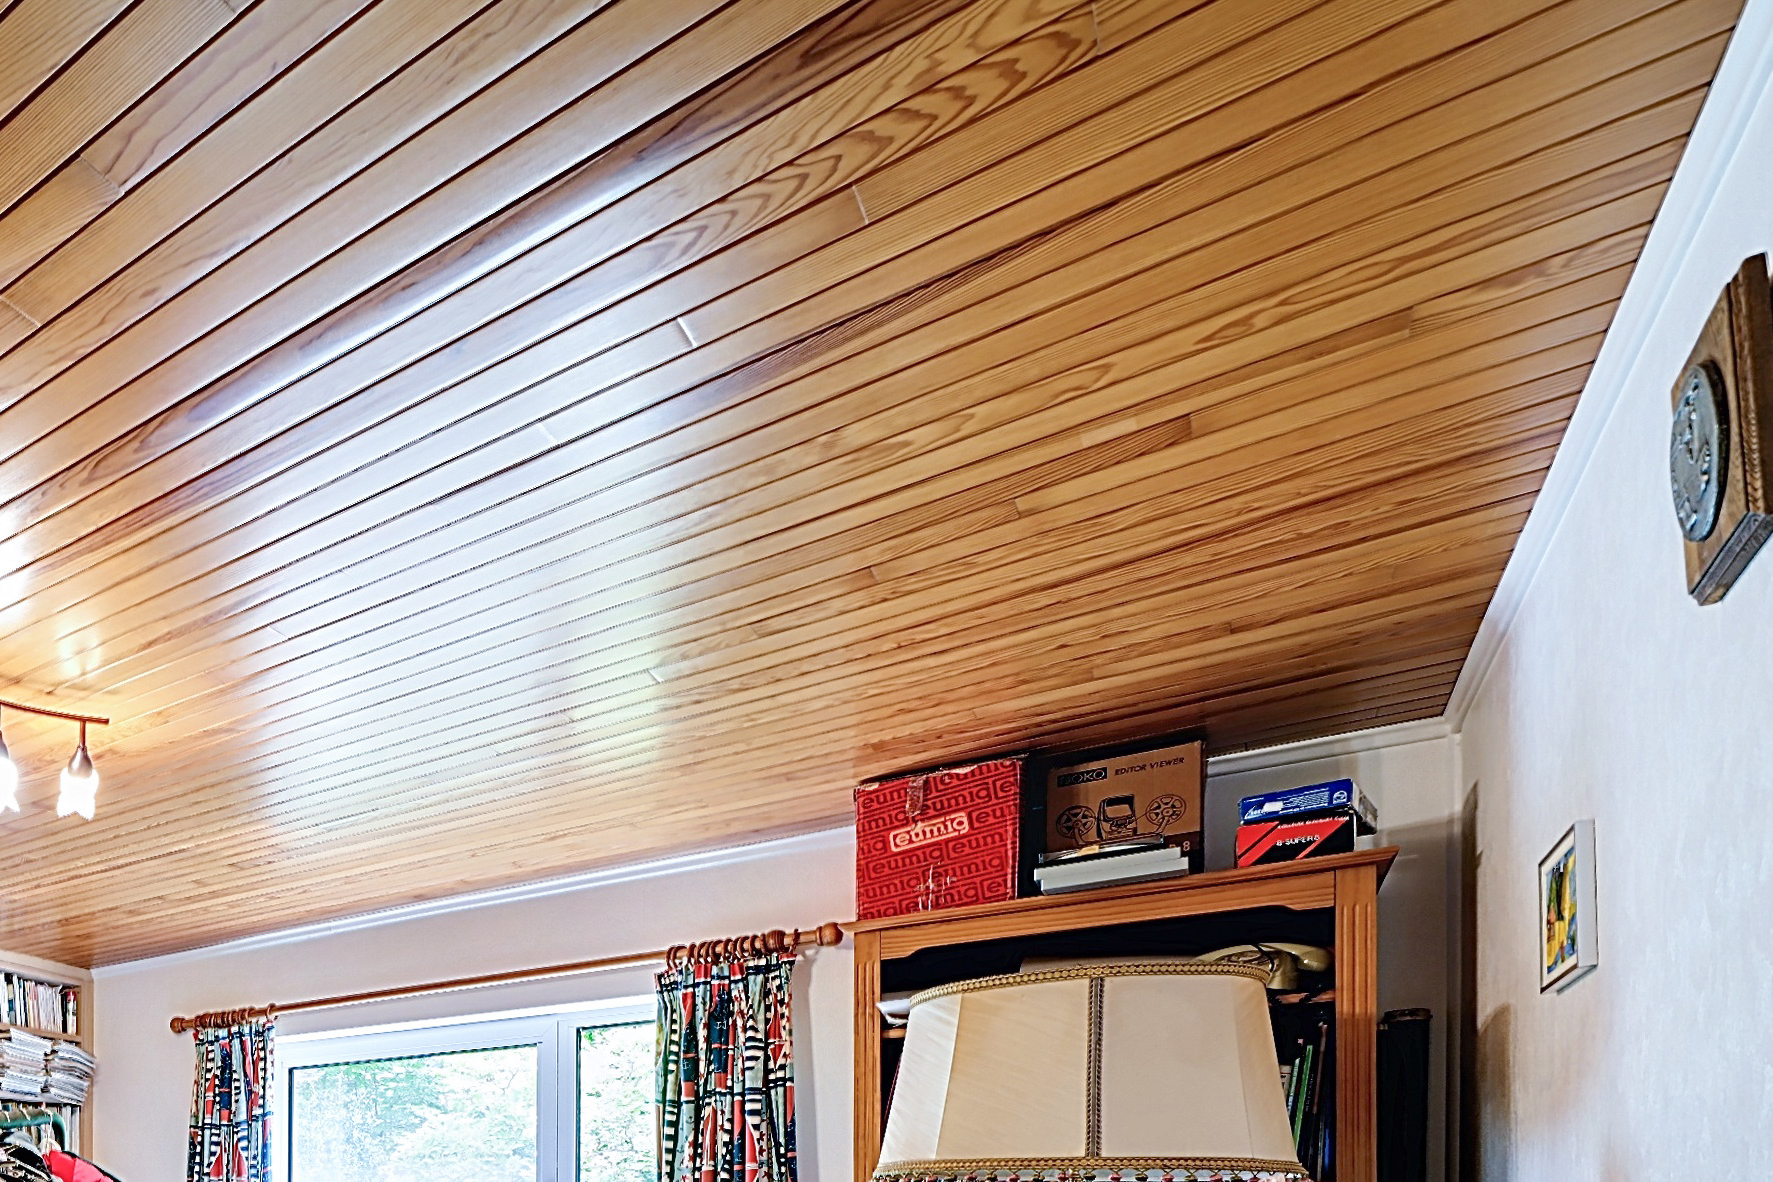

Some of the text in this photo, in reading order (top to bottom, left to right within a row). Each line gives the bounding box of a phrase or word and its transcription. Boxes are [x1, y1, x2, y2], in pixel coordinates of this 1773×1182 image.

[1114, 757, 1186, 776] EDITOR VIEWER
[894, 816, 968, 848] eumig
[1182, 840, 1191, 851] 8
[871, 845, 945, 877] eumig
